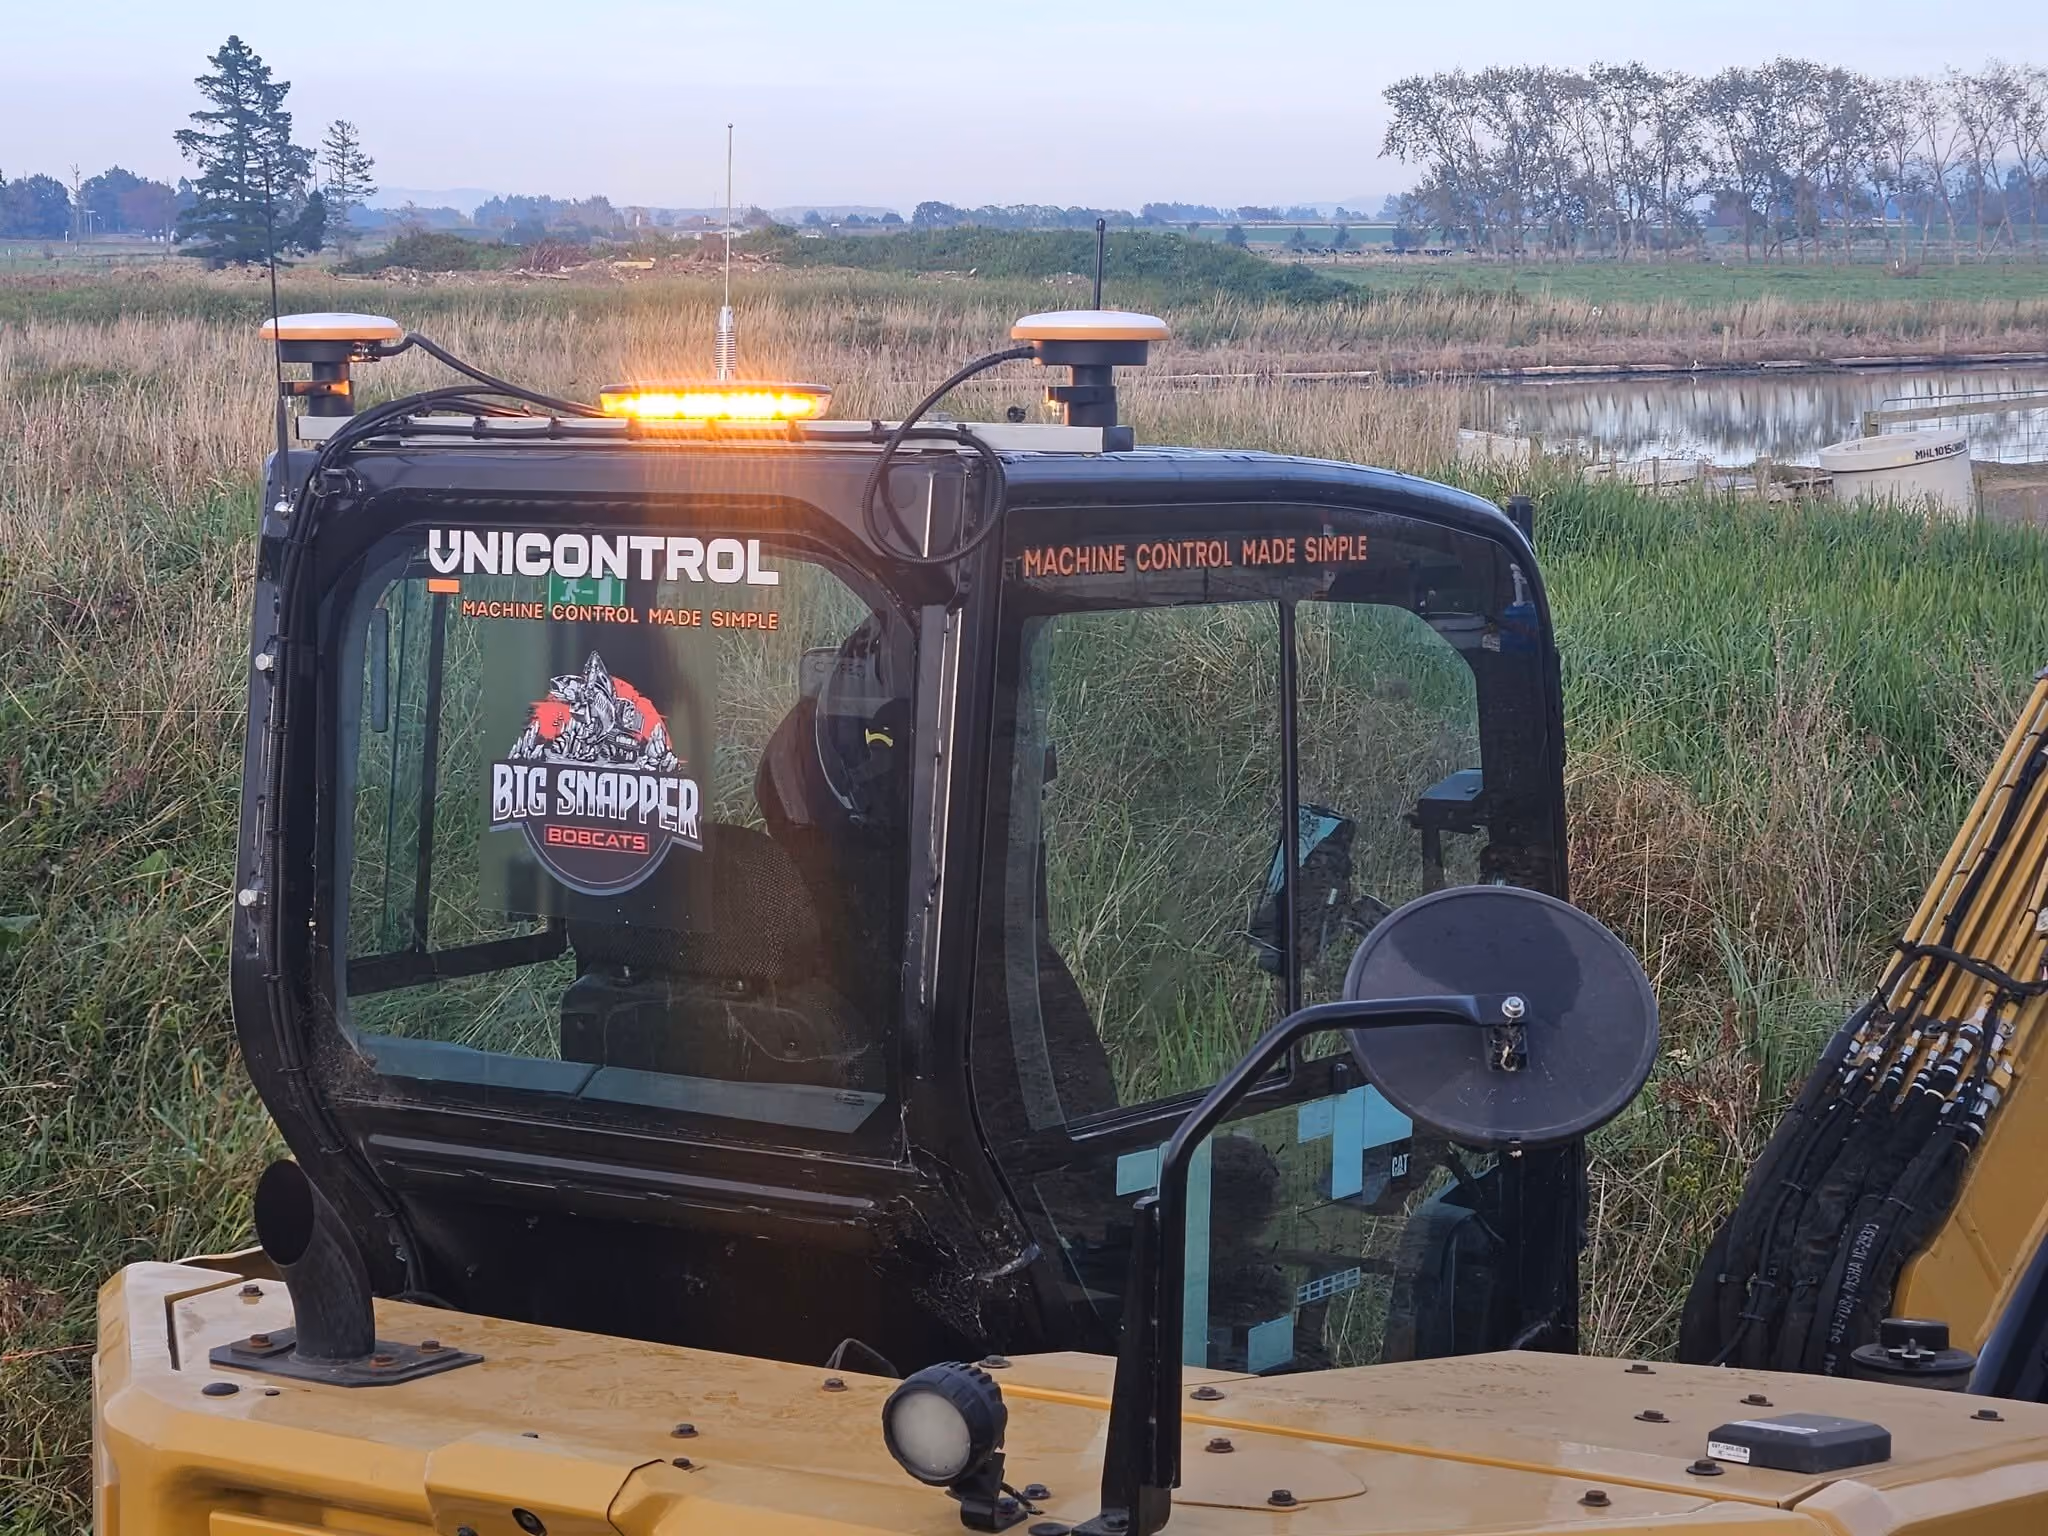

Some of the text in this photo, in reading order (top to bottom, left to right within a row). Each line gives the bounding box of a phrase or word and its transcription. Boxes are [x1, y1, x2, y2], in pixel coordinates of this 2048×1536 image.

[428, 529, 779, 586] UNICONTROL
[1024, 535, 1367, 577] MACHINE CONTROL MADE SIMPLE
[462, 600, 779, 630] MACHINE CONTROL MADE SIMPLE
[492, 763, 699, 840] BIG SNAPPER
[548, 828, 646, 850] BOBCATS
[1391, 1153, 1409, 1177] CAT
